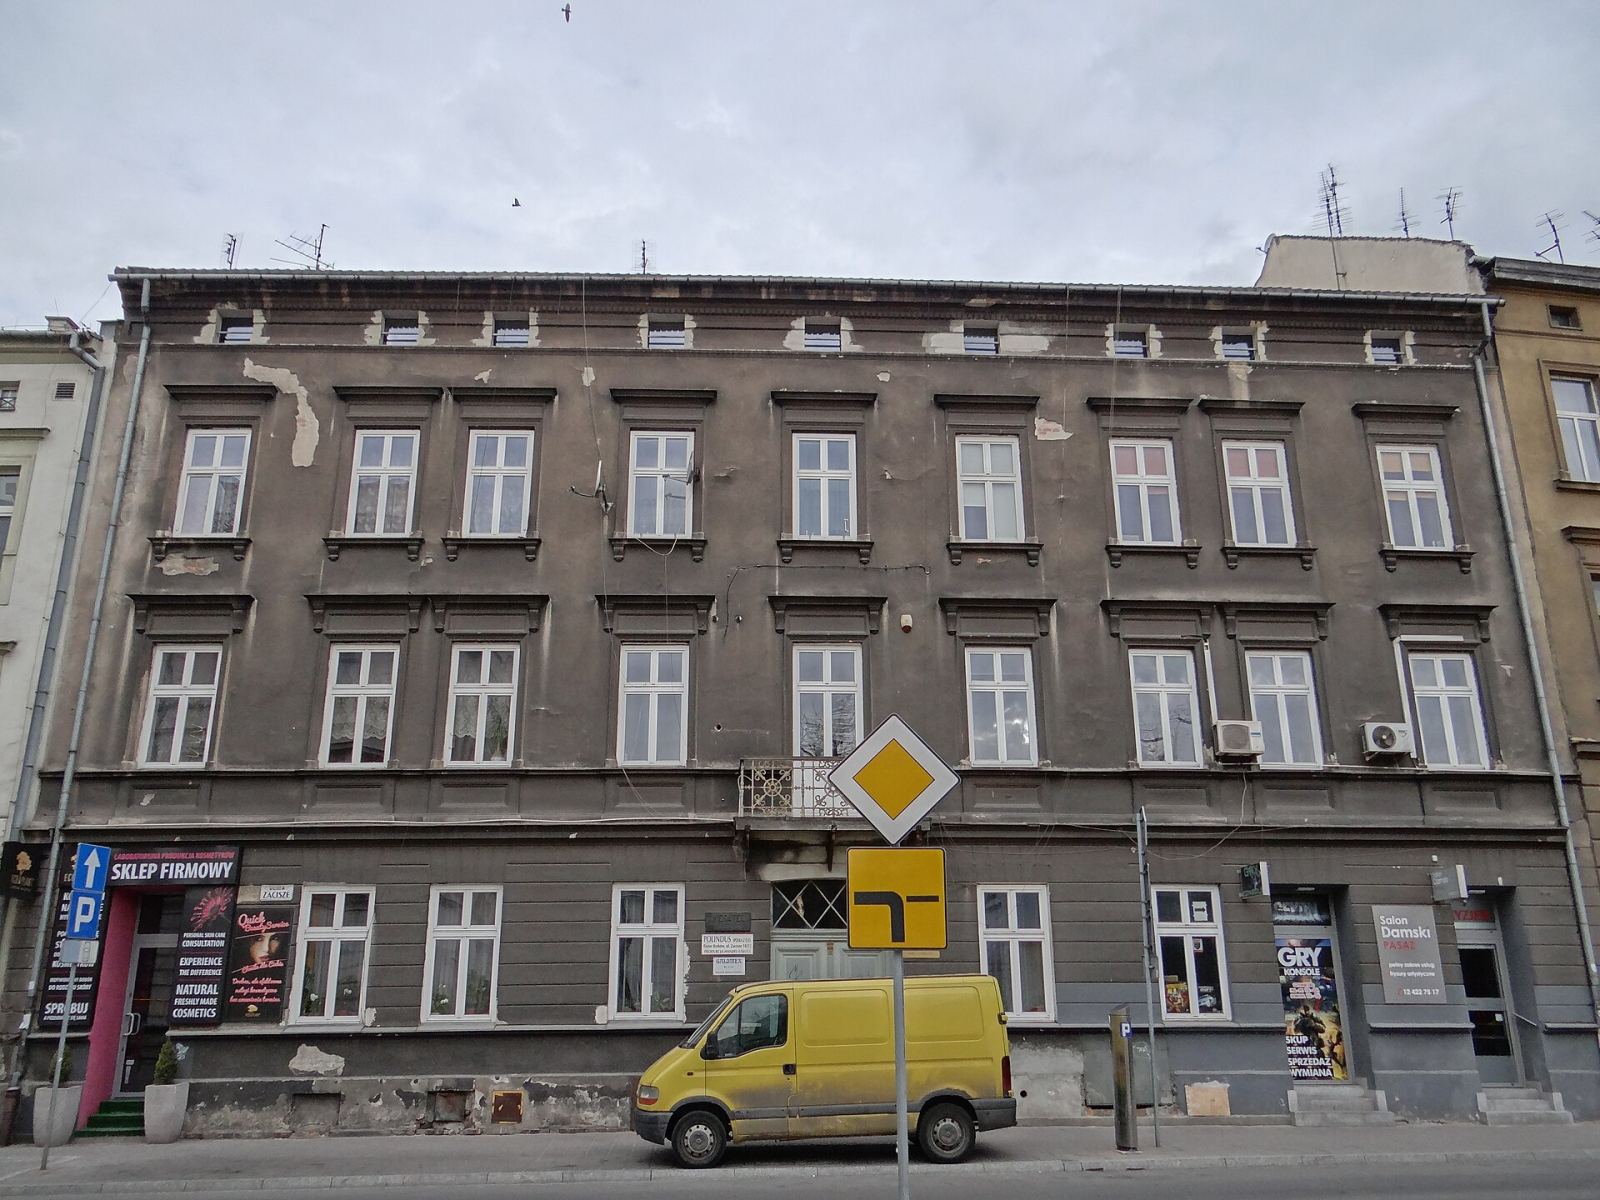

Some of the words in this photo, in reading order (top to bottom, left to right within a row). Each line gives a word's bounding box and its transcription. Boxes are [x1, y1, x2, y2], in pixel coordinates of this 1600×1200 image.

[111, 863, 158, 880] SKLEP
[160, 862, 233, 879] FIRMOWY
[74, 896, 95, 933] P
[238, 911, 266, 927] Quick
[1380, 915, 1408, 925] Salon
[1381, 926, 1431, 938] Damski
[180, 957, 223, 966] EXPERIENCE
[1278, 946, 1322, 967] GRY
[1284, 968, 1321, 976] KONSOLE
[176, 984, 219, 995] NATURAL
[174, 998, 200, 1006] FRESHLY
[200, 998, 218, 1006] MADE
[44, 1002, 89, 1015] SPRBUJ
[172, 1008, 217, 1018] COSMETICS
[1121, 1023, 1130, 1037] P
[1285, 1035, 1309, 1044] SKUP
[1286, 1046, 1318, 1055] SERWIS
[1289, 1068, 1333, 1077] WYMIANA
